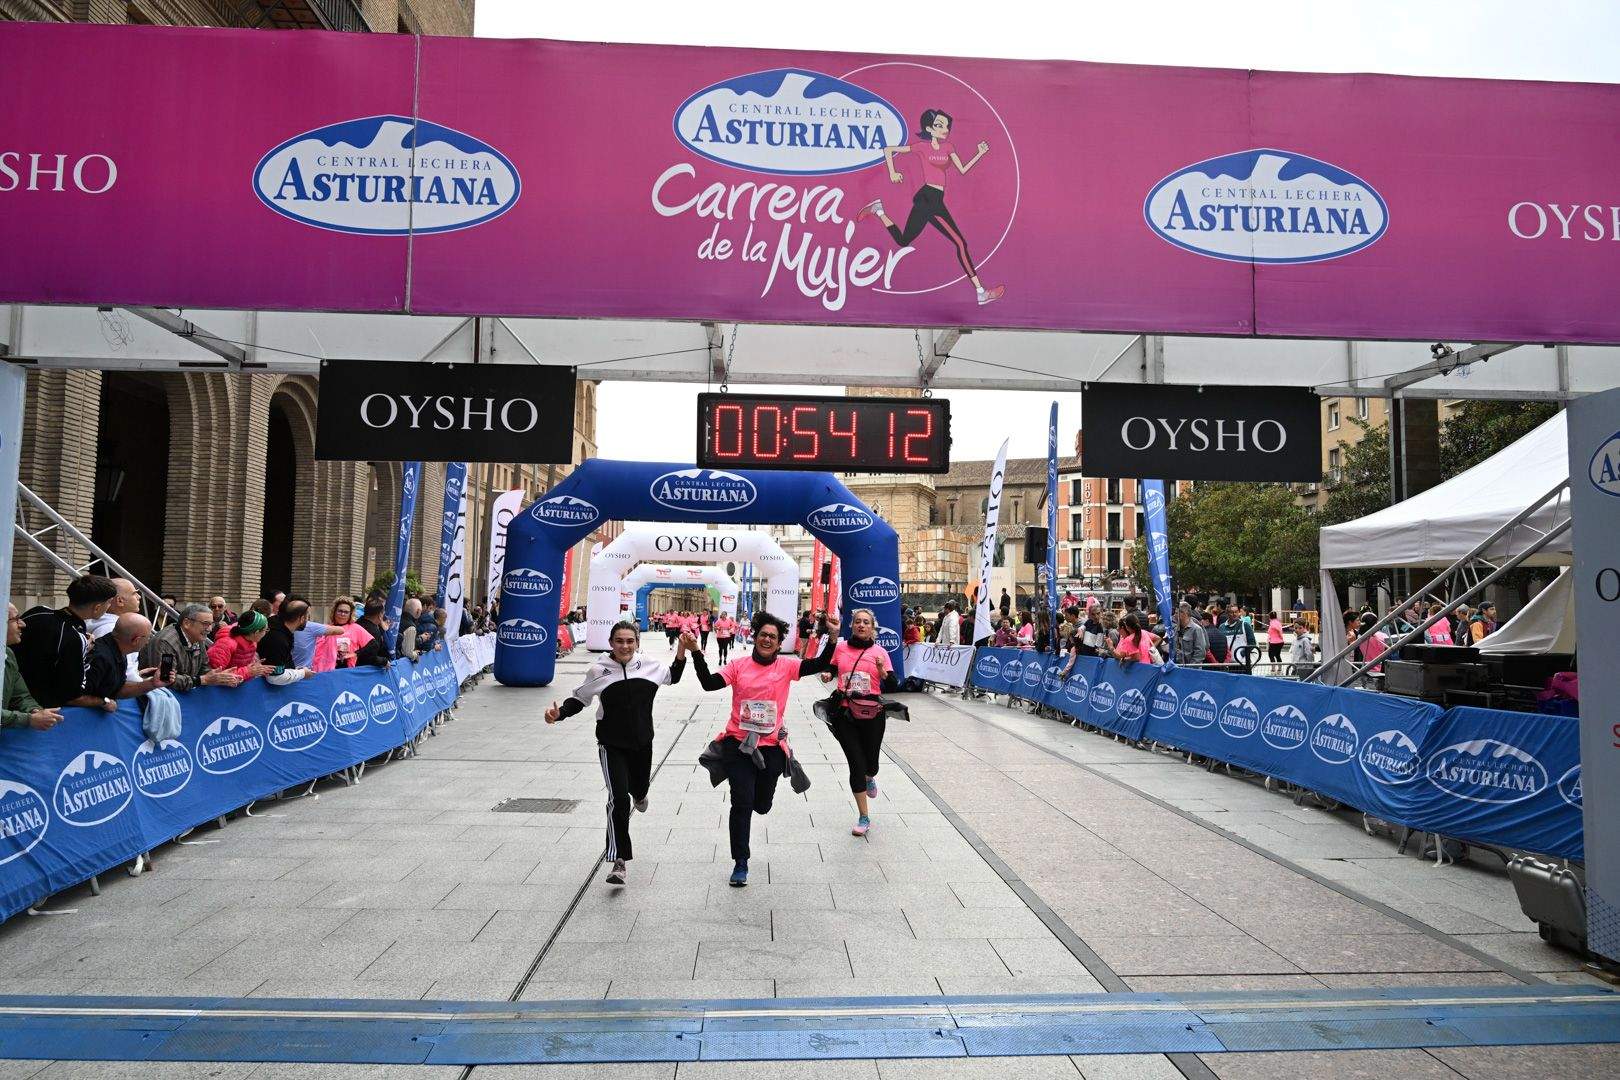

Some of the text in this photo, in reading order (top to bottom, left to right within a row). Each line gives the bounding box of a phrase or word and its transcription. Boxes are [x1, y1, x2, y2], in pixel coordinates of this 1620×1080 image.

[729, 103, 883, 119] CENTRAL LECHERA
[692, 104, 888, 151] ASTURIANA
[317, 155, 493, 170] CENTRAL LECHERA
[273, 157, 500, 206] ASTURIANA
[651, 163, 843, 225] Carrera
[1202, 188, 1362, 202] CENTRAL LECHERA
[1164, 189, 1371, 235] ASTURIANA
[697, 220, 917, 311] de la Mujer
[360, 393, 538, 433] OYSHO
[889, 410, 932, 462] 12
[1121, 416, 1287, 453] OYSHO
[658, 481, 749, 502] ASTURIANA
[535, 505, 593, 520] ASTURIANA
[812, 515, 869, 526] ASTURIANA
[655, 536, 738, 553] OYSHO
[504, 578, 549, 591] ASTURIANA
[853, 586, 897, 598] ASTURIANA
[500, 627, 543, 641] ASTURIANA
[922, 646, 960, 667] OYSHO
[335, 709, 367, 727] ASTURIANA
[1182, 702, 1214, 721] ASTURIANA
[1221, 709, 1255, 731] ASTURIANA
[274, 720, 325, 744] ASTURIANA
[1263, 718, 1304, 742] ASTURIANA
[202, 737, 261, 766] ASTURIANA
[138, 757, 191, 788] ASTURIANA
[1431, 757, 1536, 792] ASTURIANA
[62, 776, 131, 817] ASTURIANA
